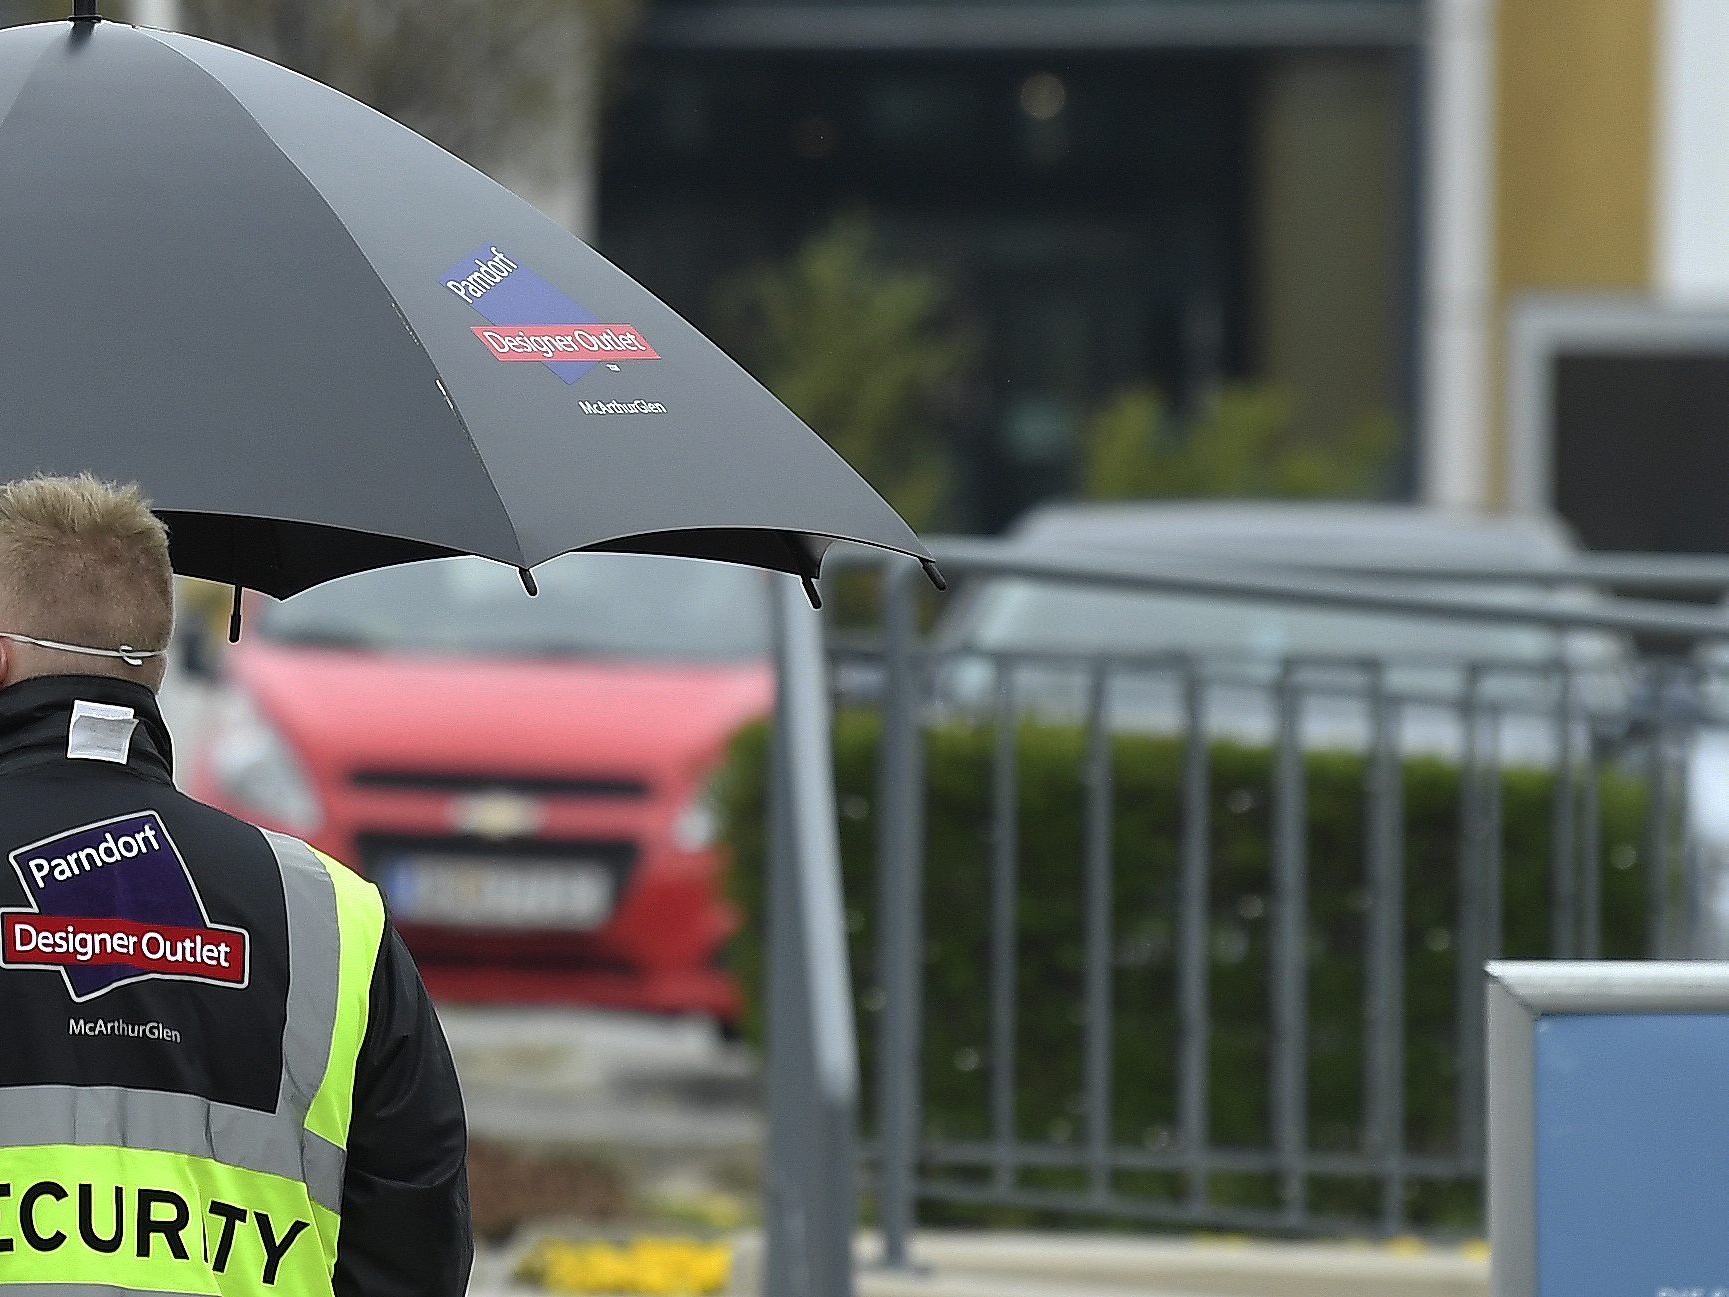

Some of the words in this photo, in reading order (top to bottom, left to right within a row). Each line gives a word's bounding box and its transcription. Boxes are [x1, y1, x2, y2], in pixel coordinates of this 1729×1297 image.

[446, 245, 518, 304] Parndorf
[482, 330, 575, 358] Designer
[573, 329, 647, 352] Outlet
[578, 399, 668, 415] McArthurGlen
[28, 822, 161, 889] Parndorf
[13, 923, 138, 961] Designer
[141, 931, 231, 967] Outlet
[68, 1018, 182, 1044] McArthurGlen
